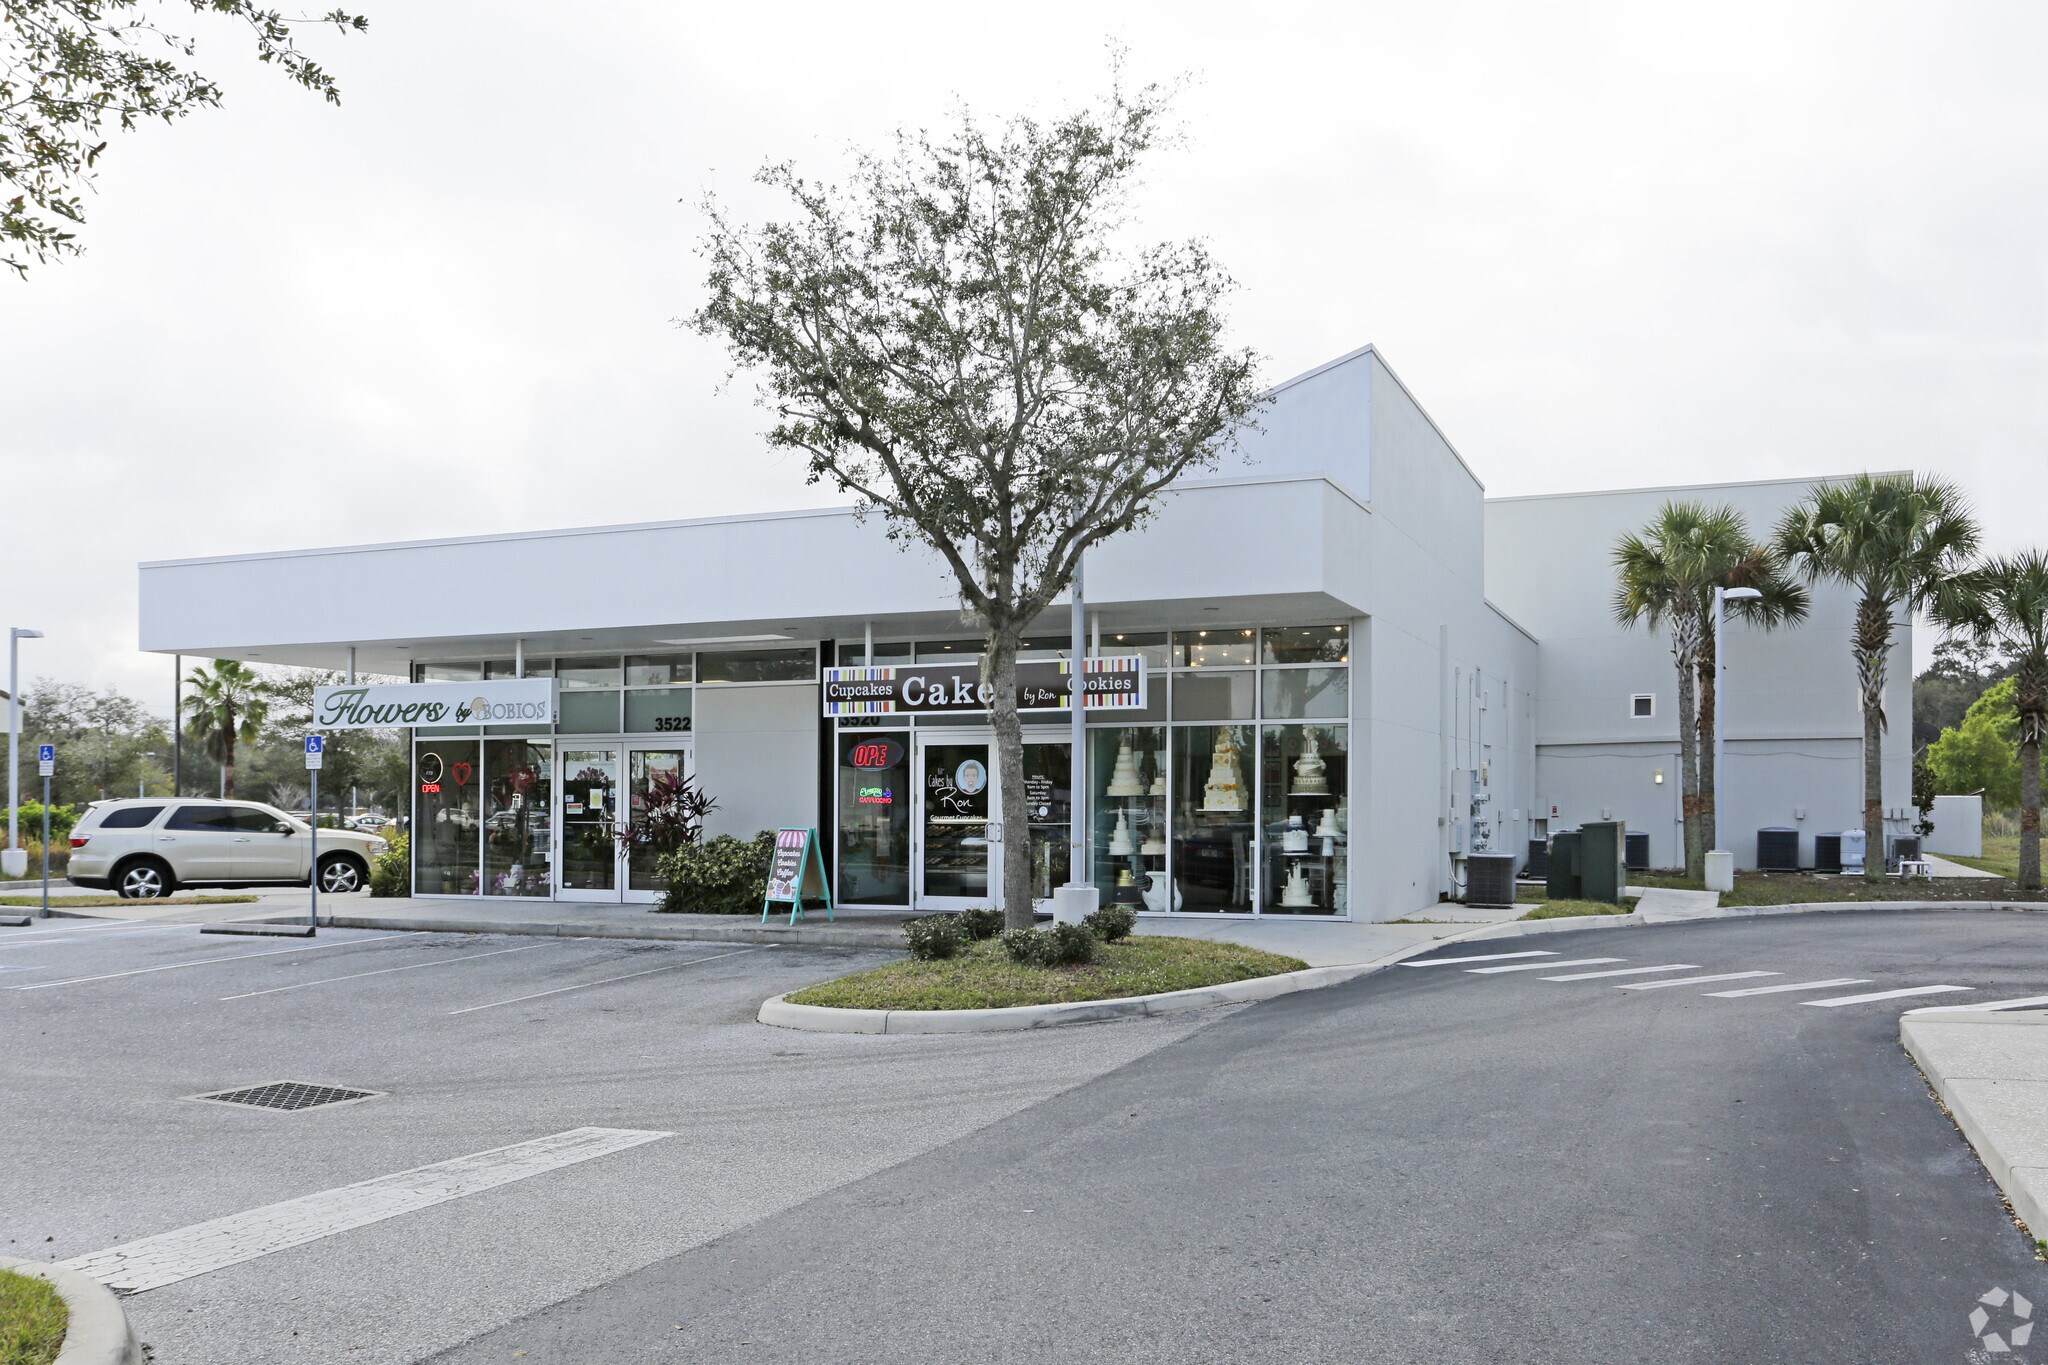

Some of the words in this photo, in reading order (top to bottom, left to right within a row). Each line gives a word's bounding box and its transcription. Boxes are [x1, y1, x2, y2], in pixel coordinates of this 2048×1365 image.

[829, 682, 893, 699] Cupcakes
[902, 675, 994, 706] Cake
[1023, 687, 1035, 705] by
[1038, 688, 1056, 700] Ron
[319, 688, 450, 726] Flowers
[455, 702, 472, 723] by
[484, 701, 546, 720] BOBIOS
[655, 717, 691, 731] 3522
[422, 784, 440, 793] OPEN
[928, 774, 945, 787] Cakes
[935, 786, 973, 814] Ron
